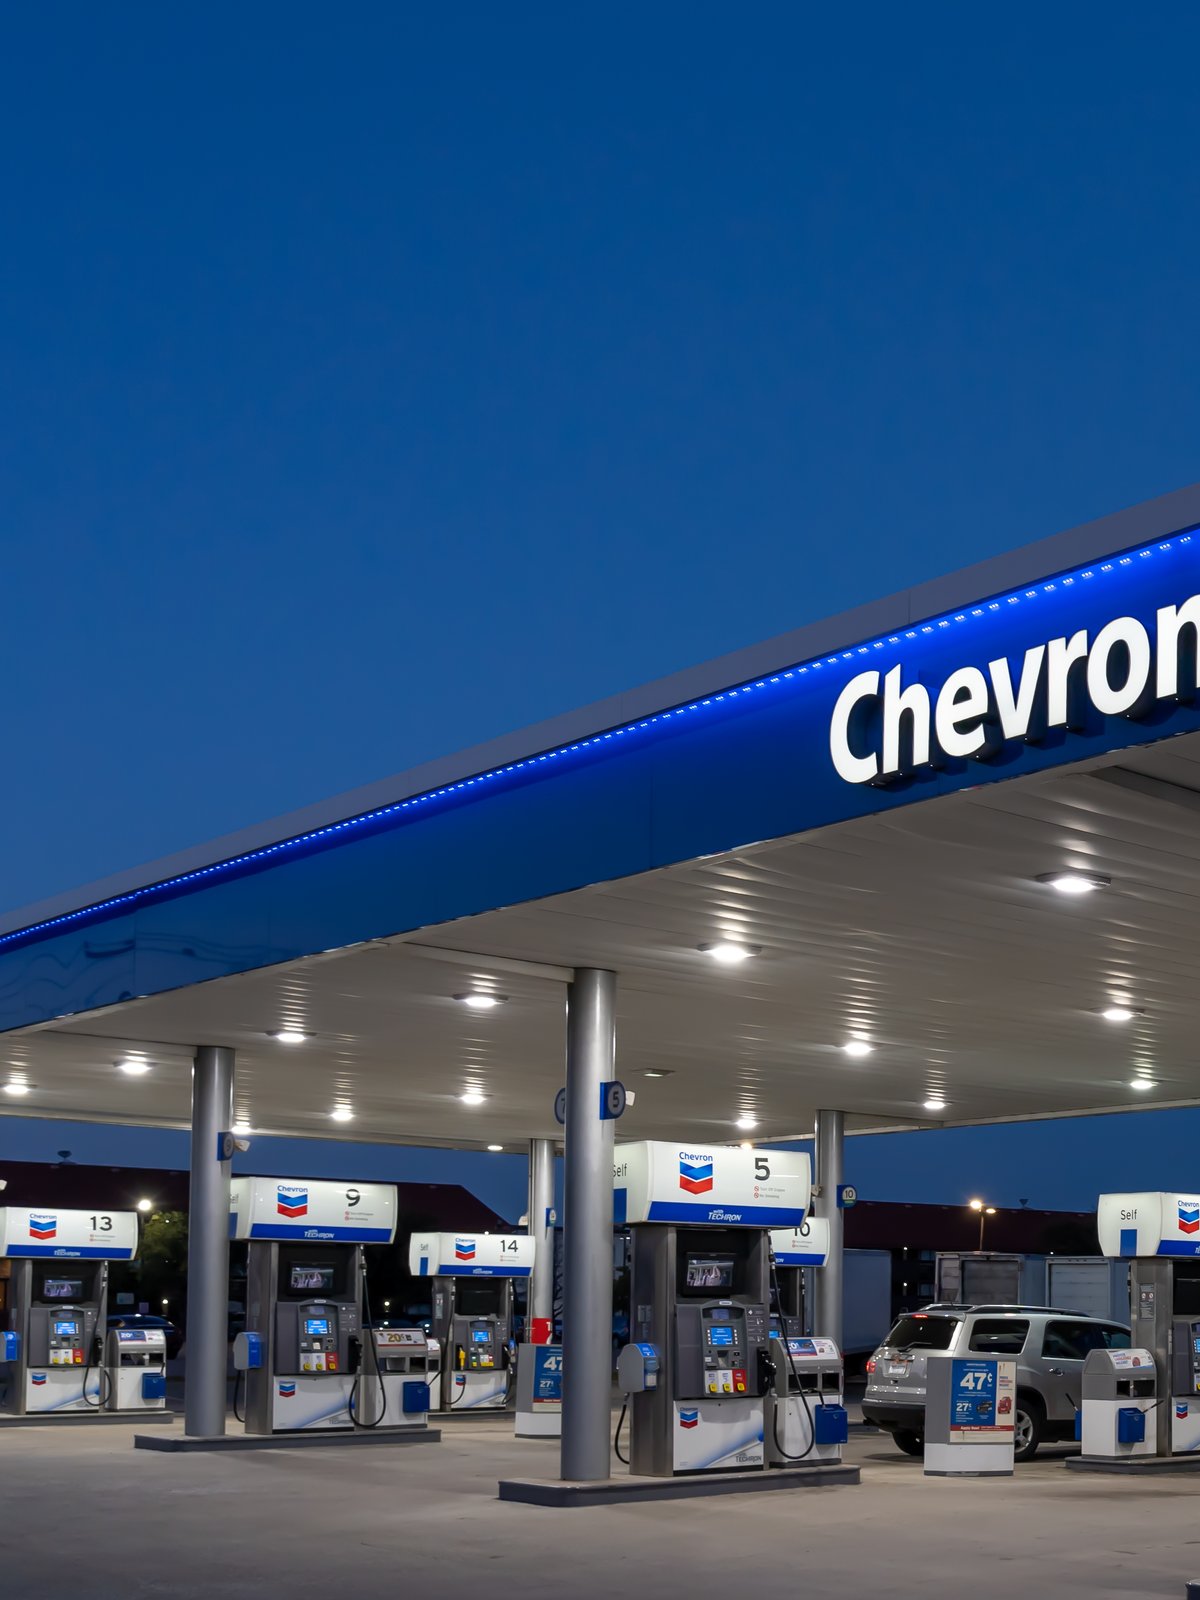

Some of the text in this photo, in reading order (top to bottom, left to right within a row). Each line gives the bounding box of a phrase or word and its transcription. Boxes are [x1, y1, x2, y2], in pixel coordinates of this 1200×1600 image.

[612, 1091, 620, 1108] 5
[679, 1152, 713, 1162] Chevron
[754, 1157, 771, 1181] 5
[277, 1185, 308, 1193] Chevron
[844, 1190, 854, 1198] 10
[346, 1188, 361, 1207] 9
[1178, 1200, 1200, 1208] Chevron
[708, 1212, 742, 1222] TECHRON
[1120, 1209, 1137, 1220] Self
[90, 1216, 113, 1231] 13
[500, 1240, 518, 1252] 14
